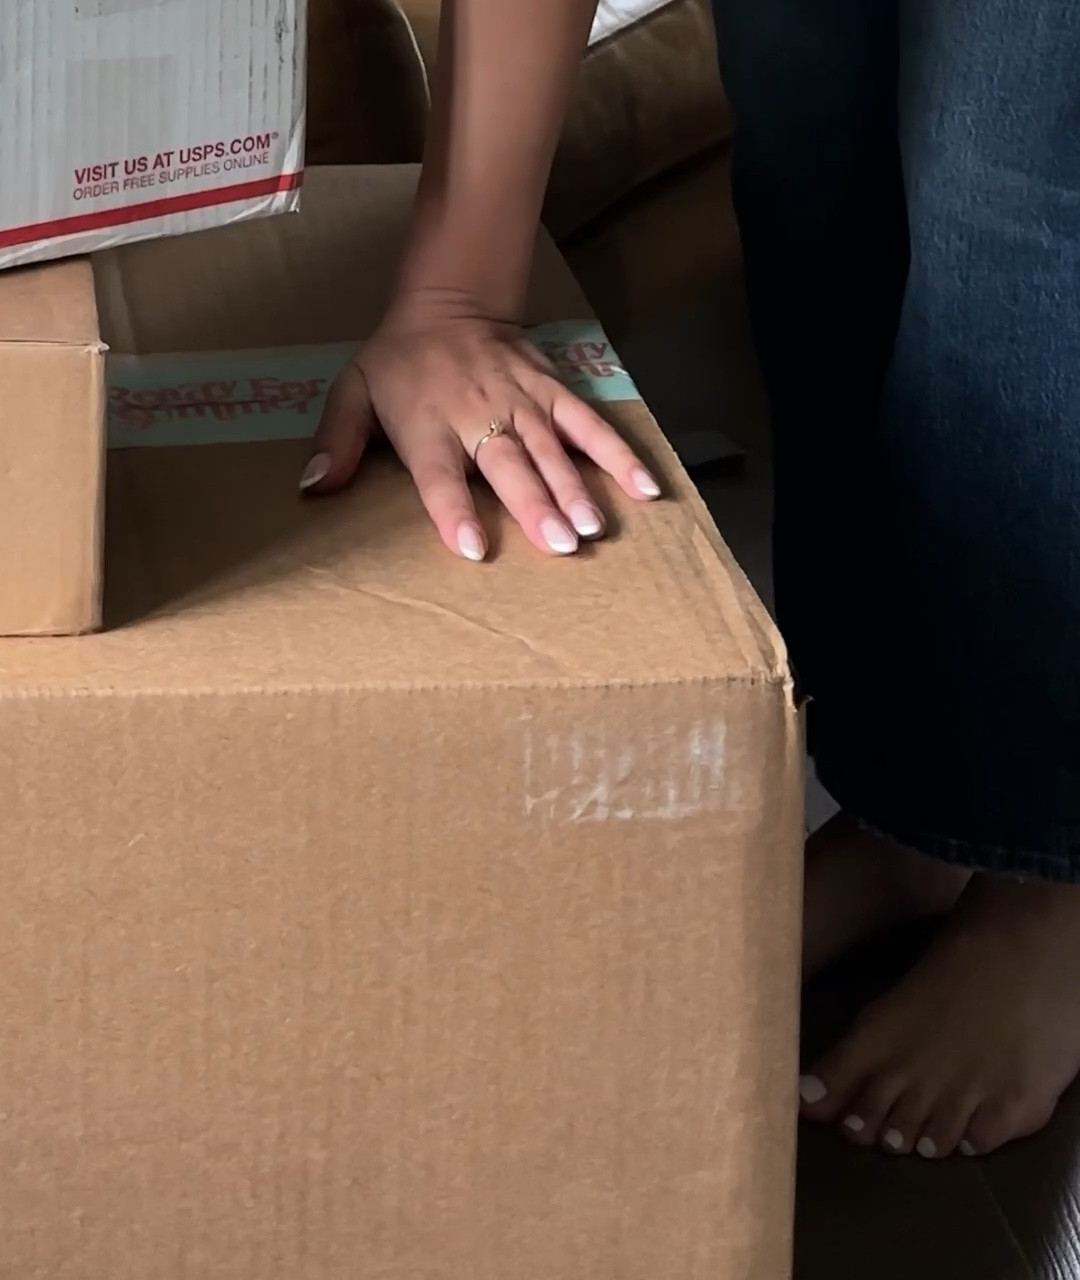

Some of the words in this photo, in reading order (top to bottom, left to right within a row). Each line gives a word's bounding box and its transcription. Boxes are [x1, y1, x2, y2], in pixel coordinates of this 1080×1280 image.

[72, 181, 120, 200] ORDER
[122, 174, 156, 190] FREE
[158, 160, 221, 184] SUPPLIES
[222, 151, 270, 171] ONLINE
[74, 161, 120, 186] VISIT
[123, 156, 149, 176] US
[152, 151, 175, 171] AT
